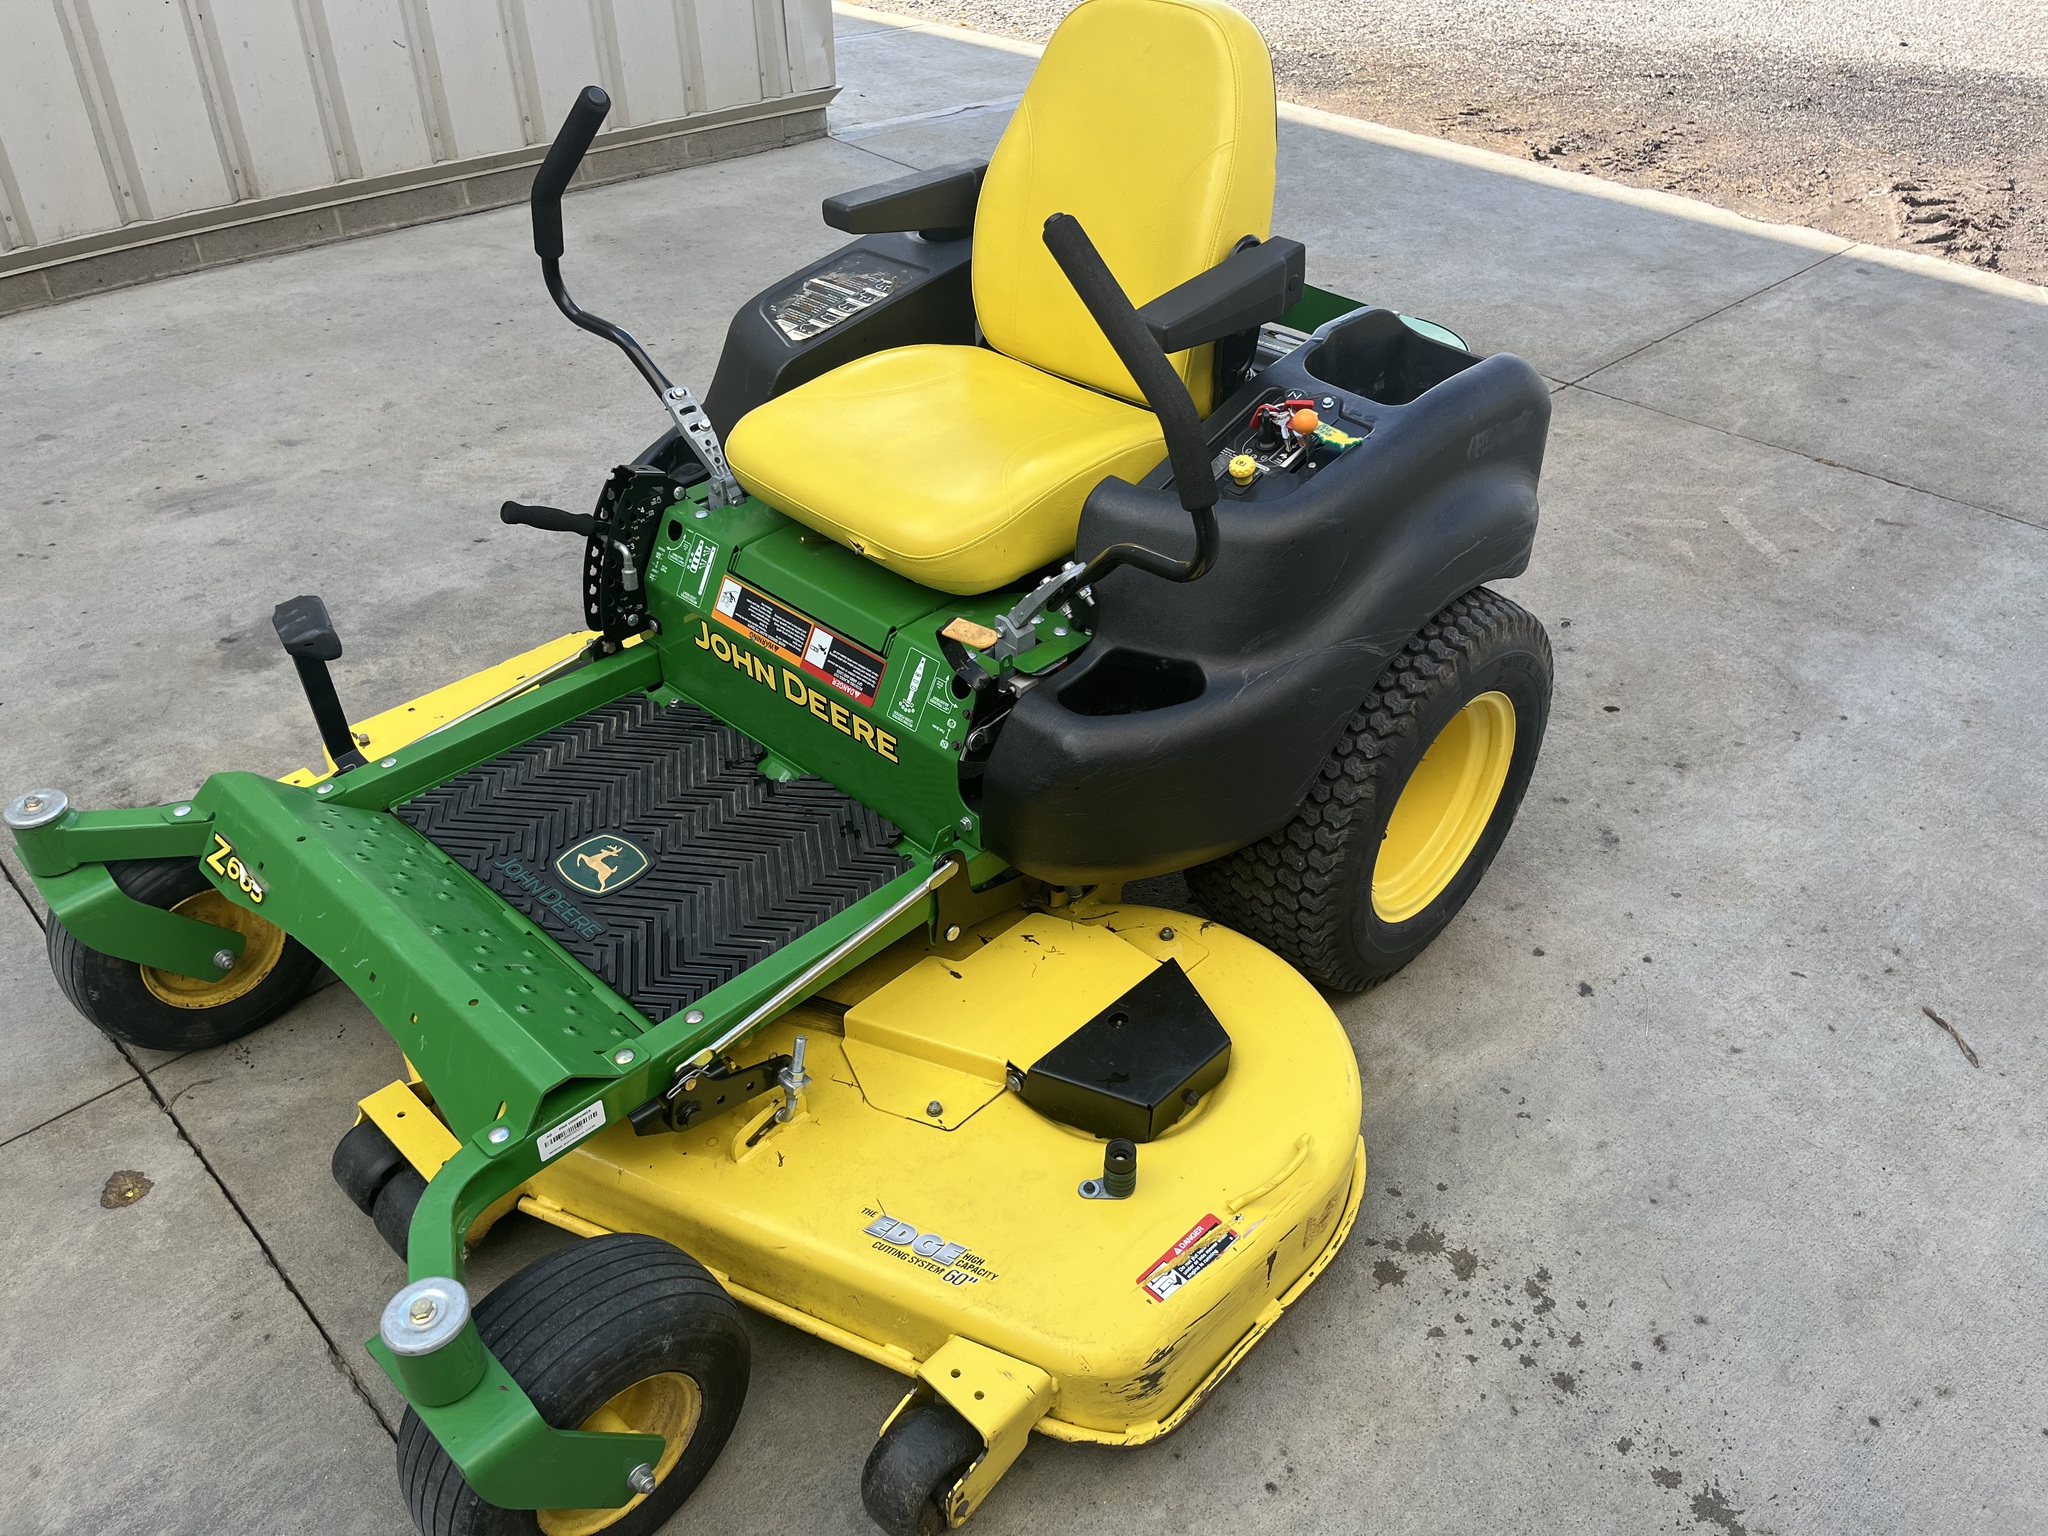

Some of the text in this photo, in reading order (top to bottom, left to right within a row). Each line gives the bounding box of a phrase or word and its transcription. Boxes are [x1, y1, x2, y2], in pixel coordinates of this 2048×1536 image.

[747, 630, 775, 650] WARNING
[694, 620, 777, 693] JOHN
[782, 667, 899, 765] DEERE
[830, 677, 856, 696] DANGER
[494, 857, 603, 939] JOHN DEERE
[861, 1207, 878, 1218] THE
[862, 1214, 968, 1266] EDGE
[1179, 1225, 1204, 1249] DANGER
[872, 1241, 944, 1275] CUTTING SYSTEM
[963, 1253, 985, 1266] HIGH
[943, 1270, 978, 1286] 60"
[955, 1260, 999, 1281] CAPACITY
